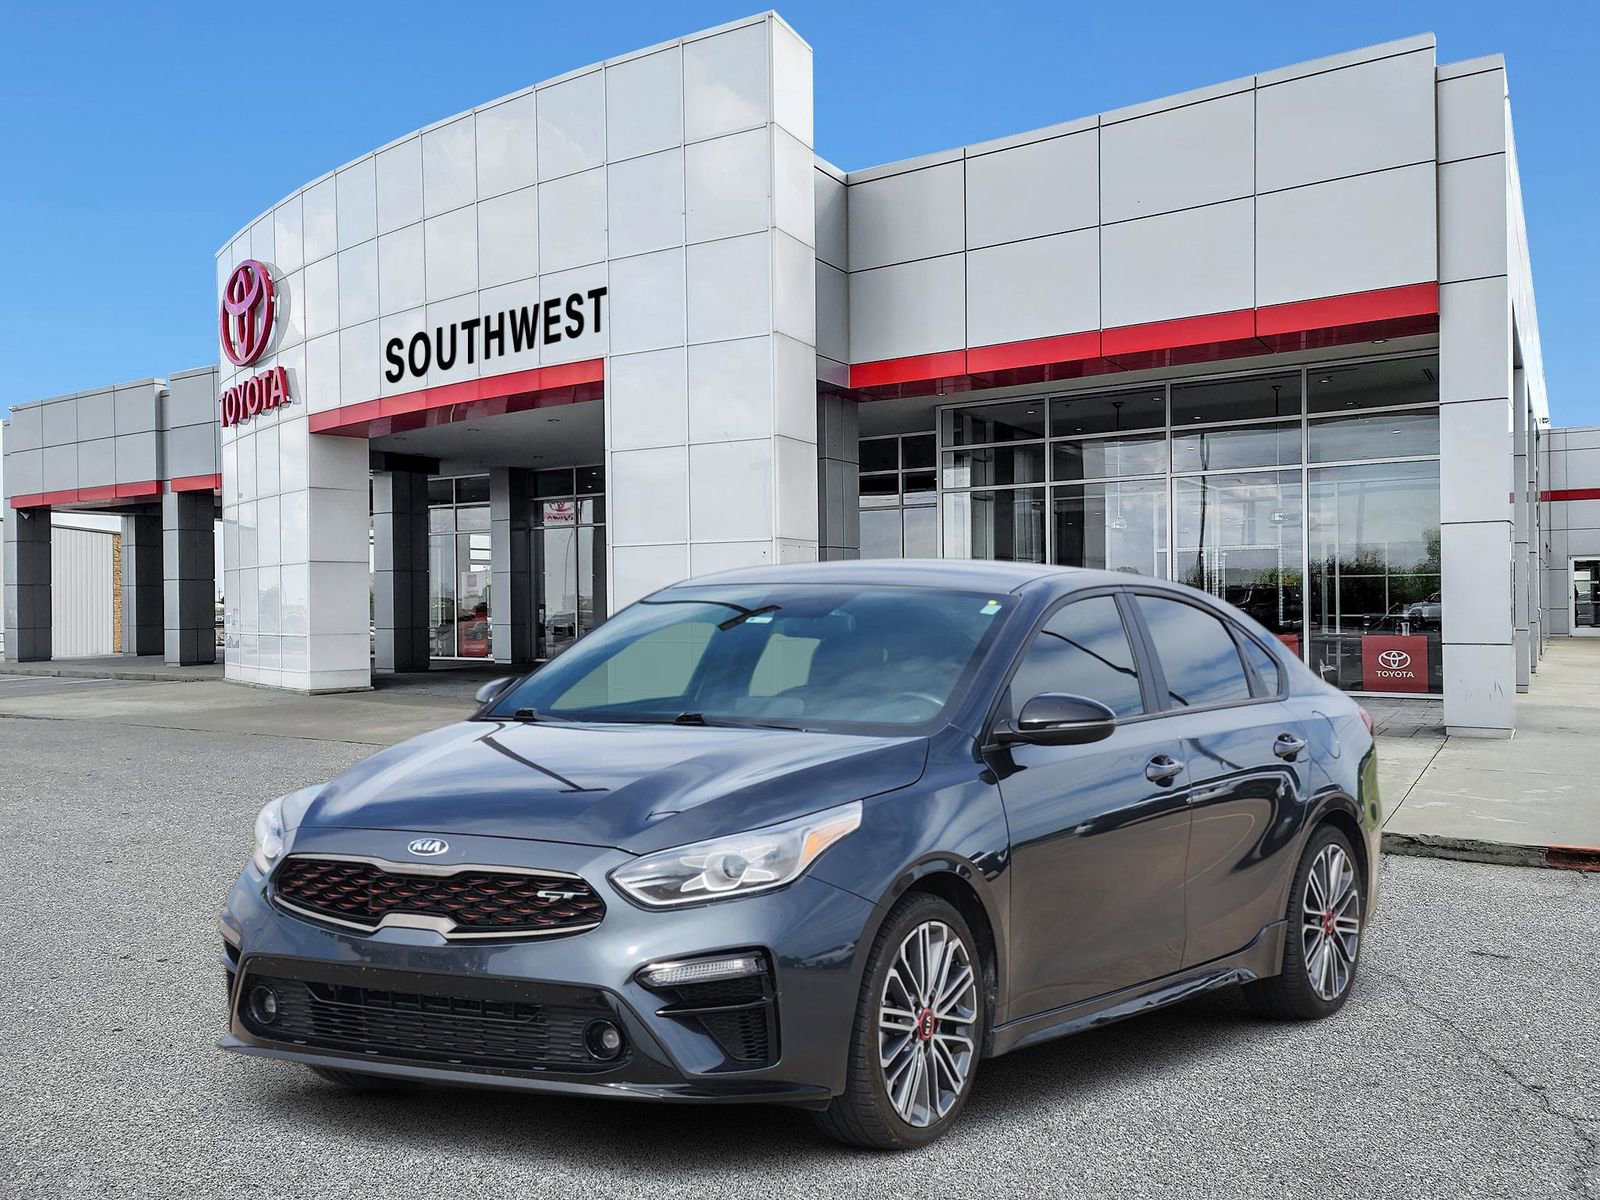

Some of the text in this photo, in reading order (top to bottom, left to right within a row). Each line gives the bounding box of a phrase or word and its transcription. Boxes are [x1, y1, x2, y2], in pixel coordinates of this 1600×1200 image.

[385, 286, 608, 384] SOUTHWEST
[218, 366, 291, 428] TOYOTA
[1376, 670, 1414, 678] TOYOTA
[412, 840, 441, 852] KIA
